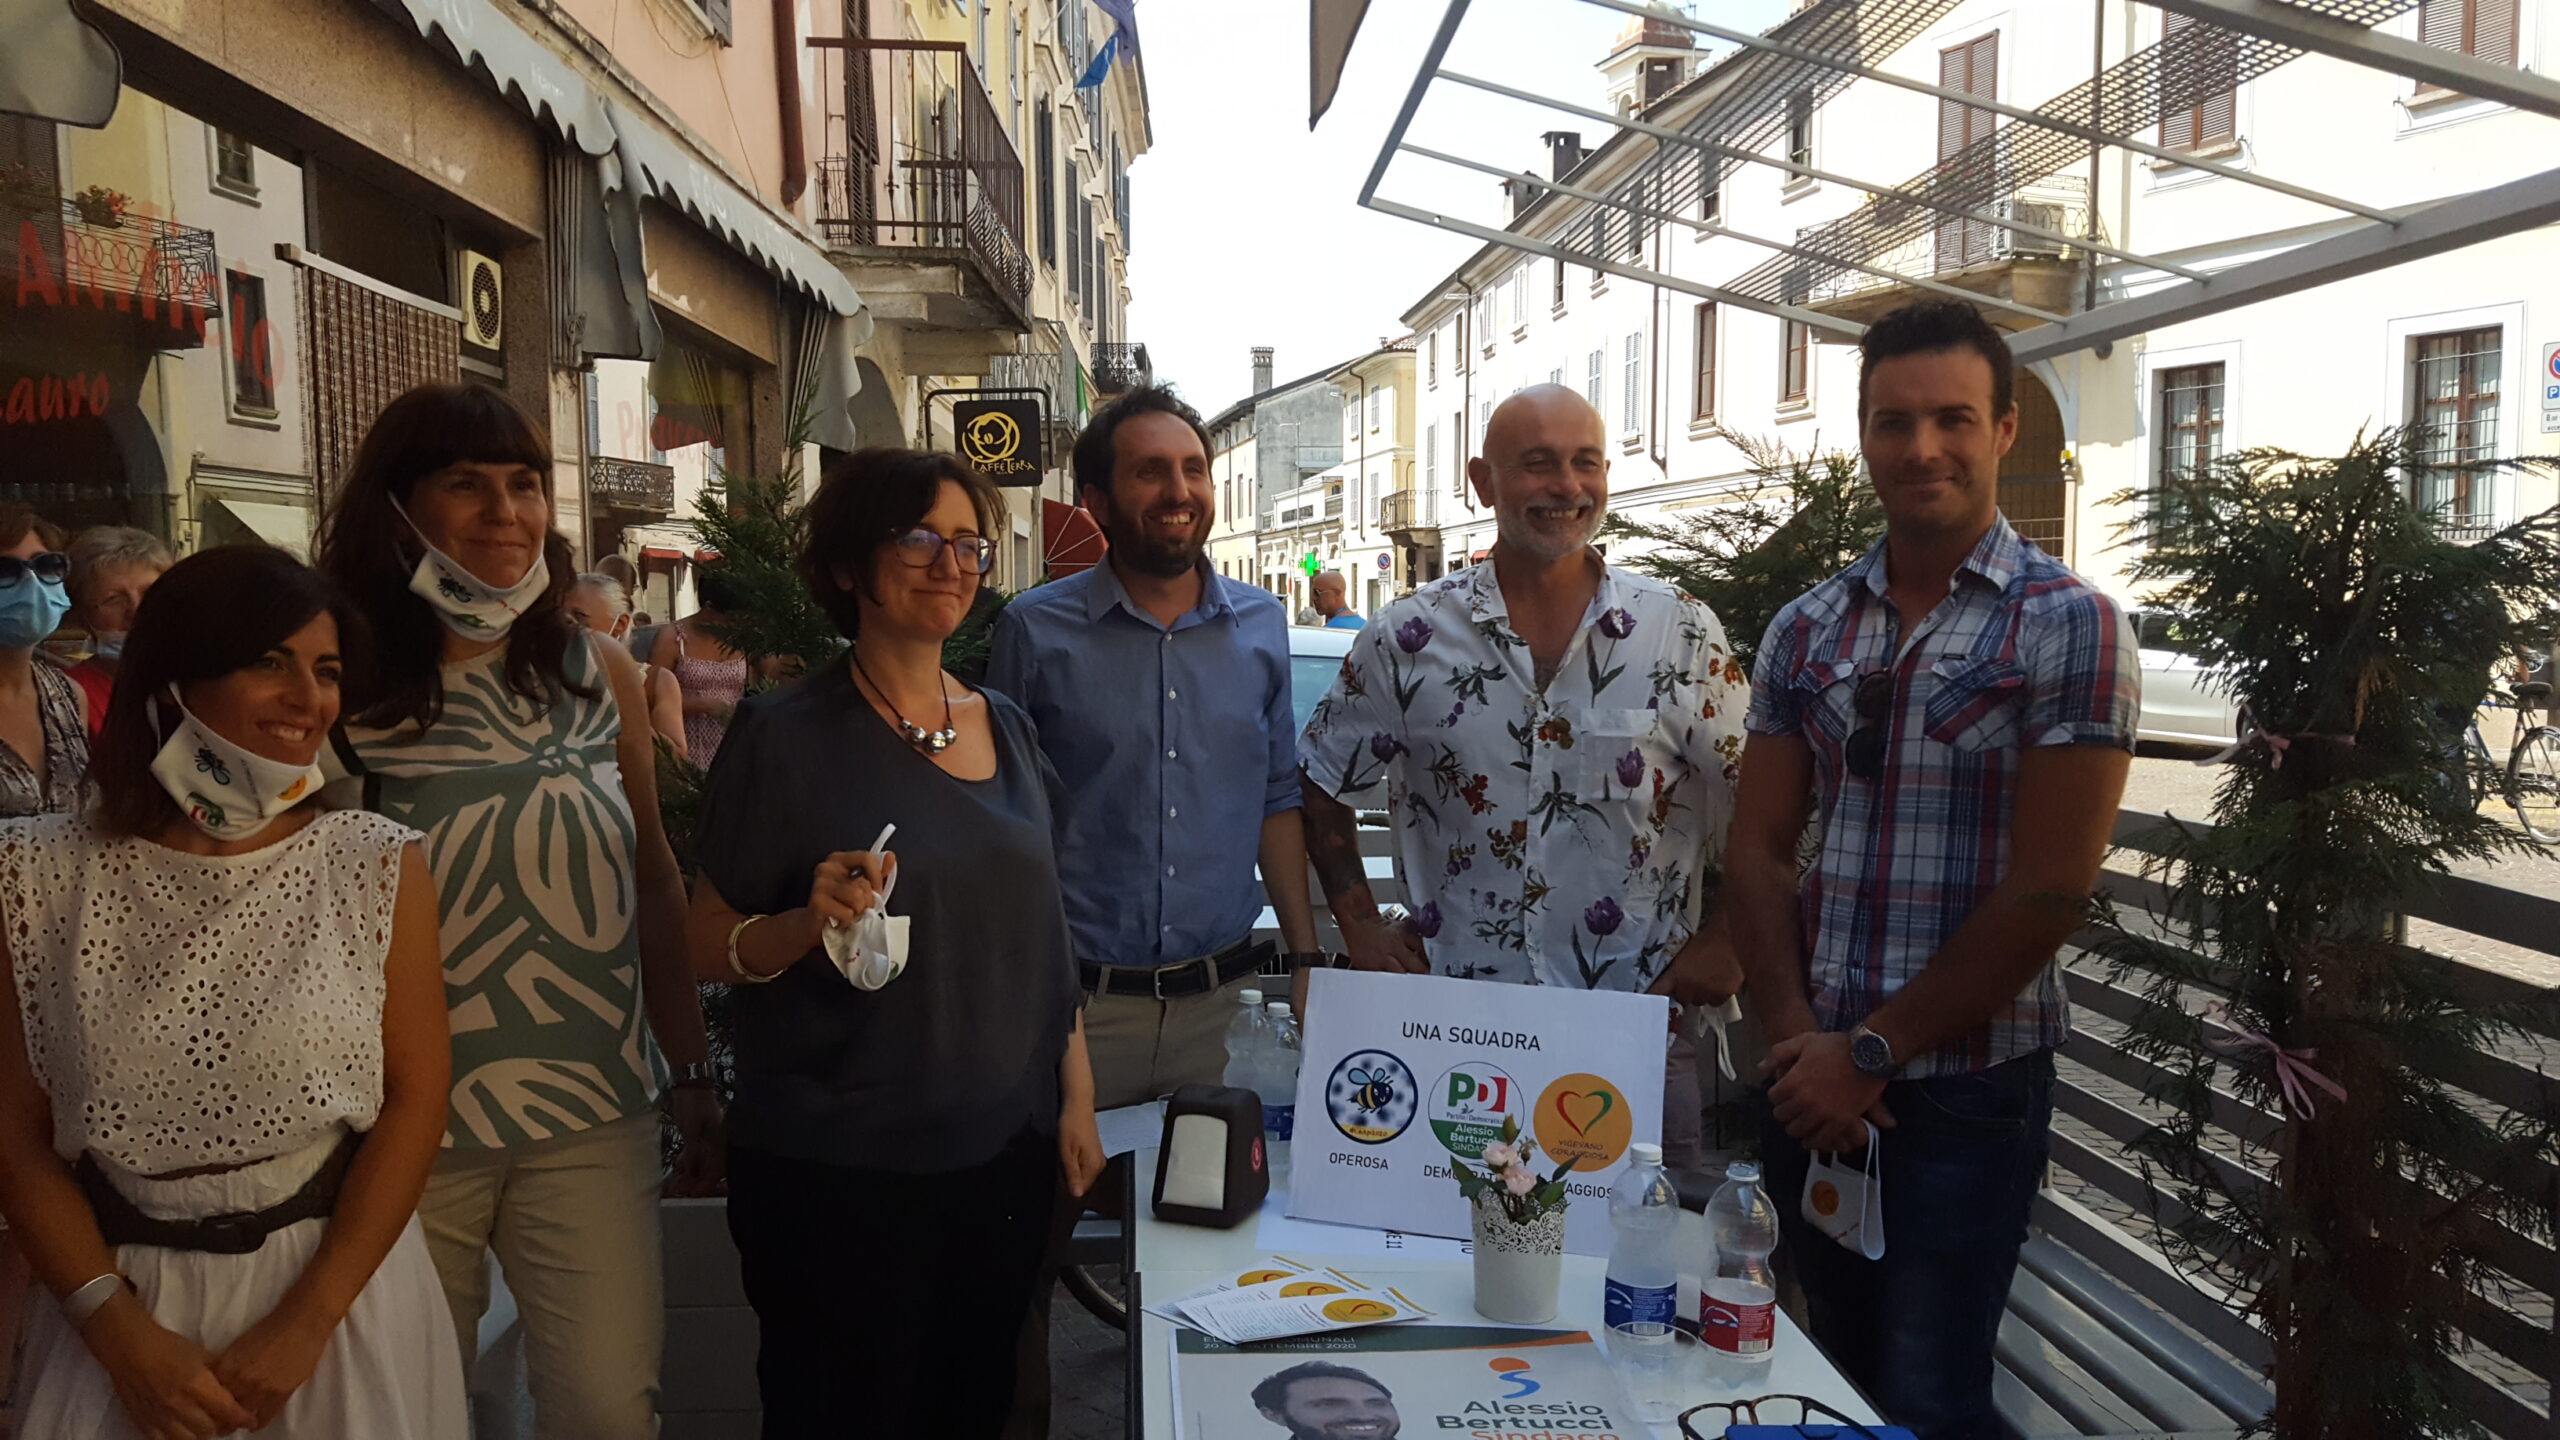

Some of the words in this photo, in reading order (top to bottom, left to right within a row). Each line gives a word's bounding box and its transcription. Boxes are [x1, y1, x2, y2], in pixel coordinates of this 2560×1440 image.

[0, 371, 111, 424] auro
[1402, 1021, 1442, 1041] UNA
[1448, 1026, 1541, 1052] SQUADRA
[1447, 1072, 1508, 1113] PD
[1455, 1123, 1494, 1137] Alessio
[1558, 1139, 1604, 1151] VIGEVANO
[1329, 1152, 1389, 1170] OPEROSA
[1281, 1336, 1355, 1344] OMUNALI
[1463, 1400, 1603, 1415] Alessio
[1436, 1415, 1614, 1430] Bertucci
[1471, 1430, 1620, 1440] Sindaco
